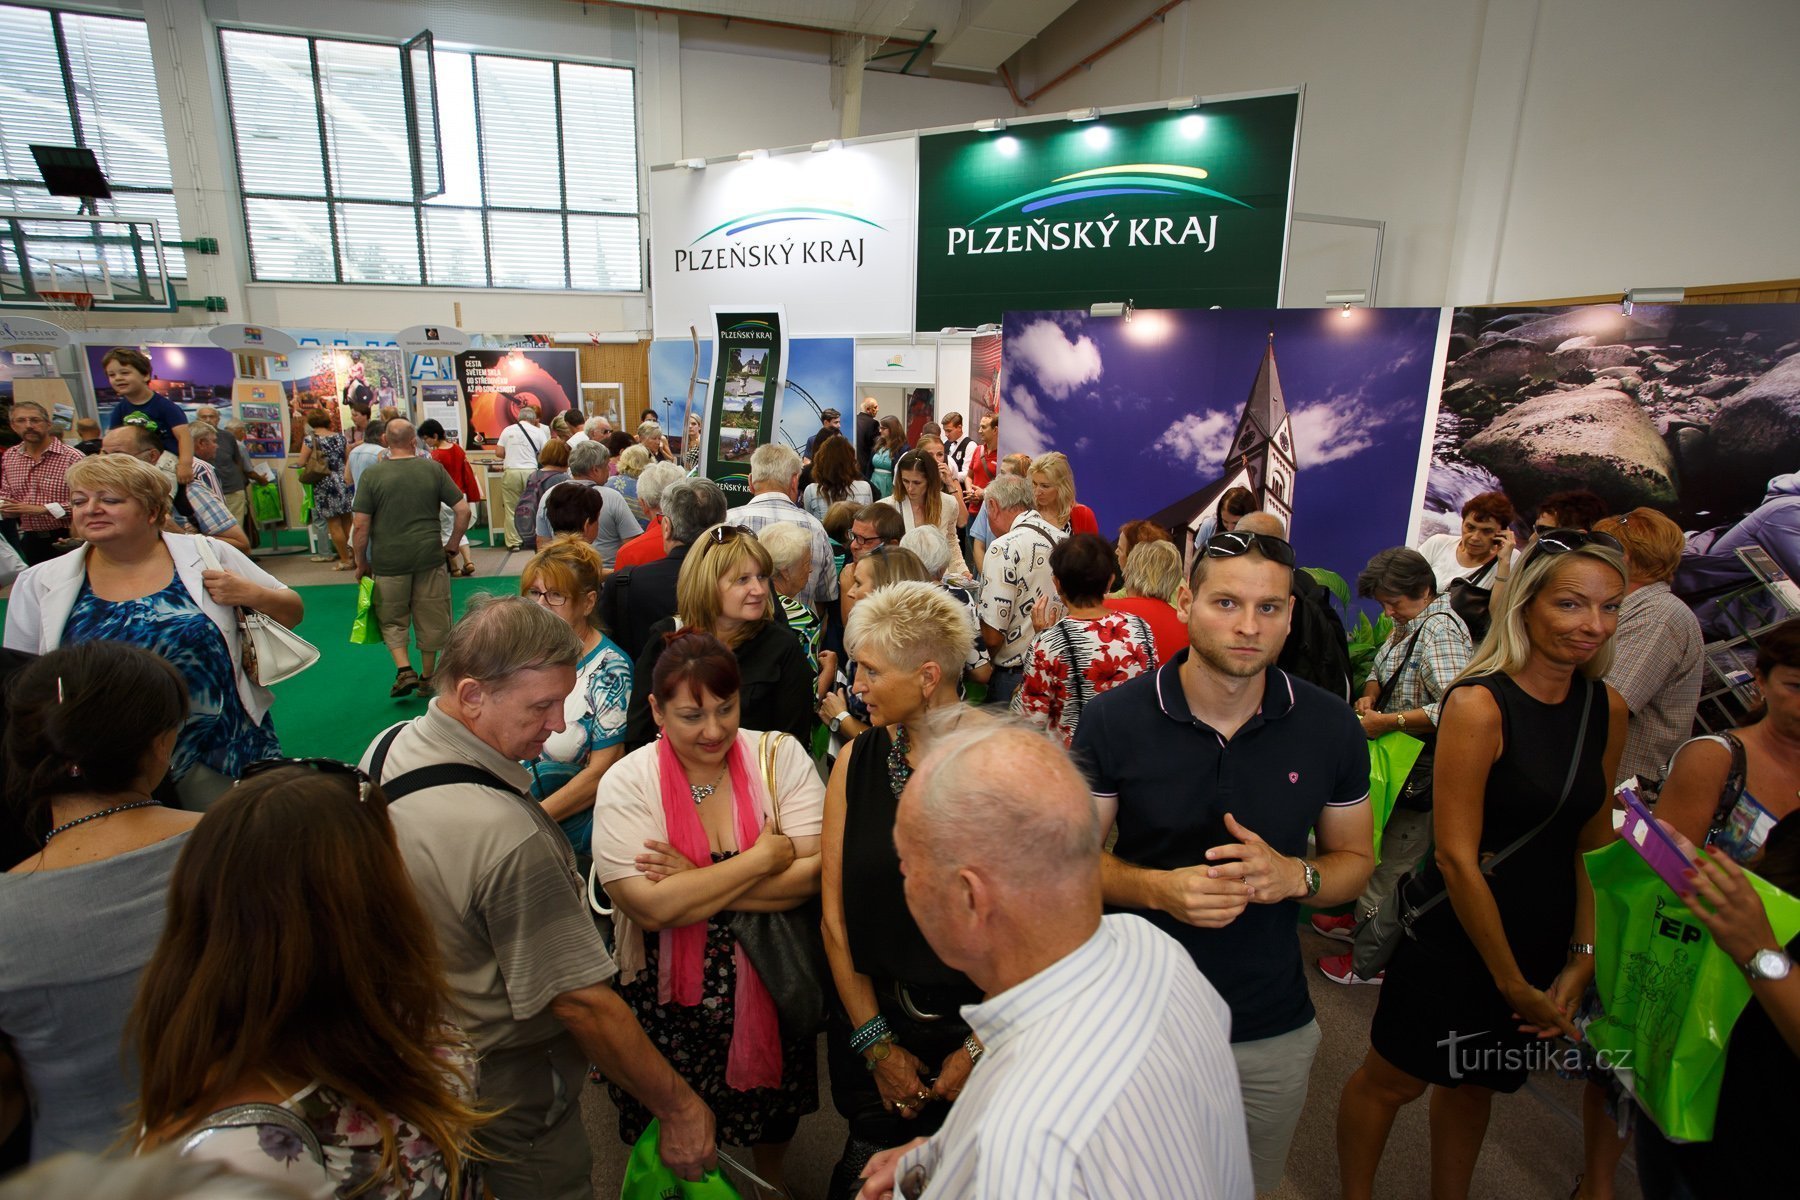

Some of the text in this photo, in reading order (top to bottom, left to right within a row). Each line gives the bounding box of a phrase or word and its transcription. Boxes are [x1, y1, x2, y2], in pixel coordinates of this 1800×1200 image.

[947, 212, 1219, 256] PLZEŇSKÝ KRAJ
[675, 237, 864, 272] PLZEŇSKÝ KRAJ
[720, 330, 772, 341] PLZEŇSKÝ KRAJ
